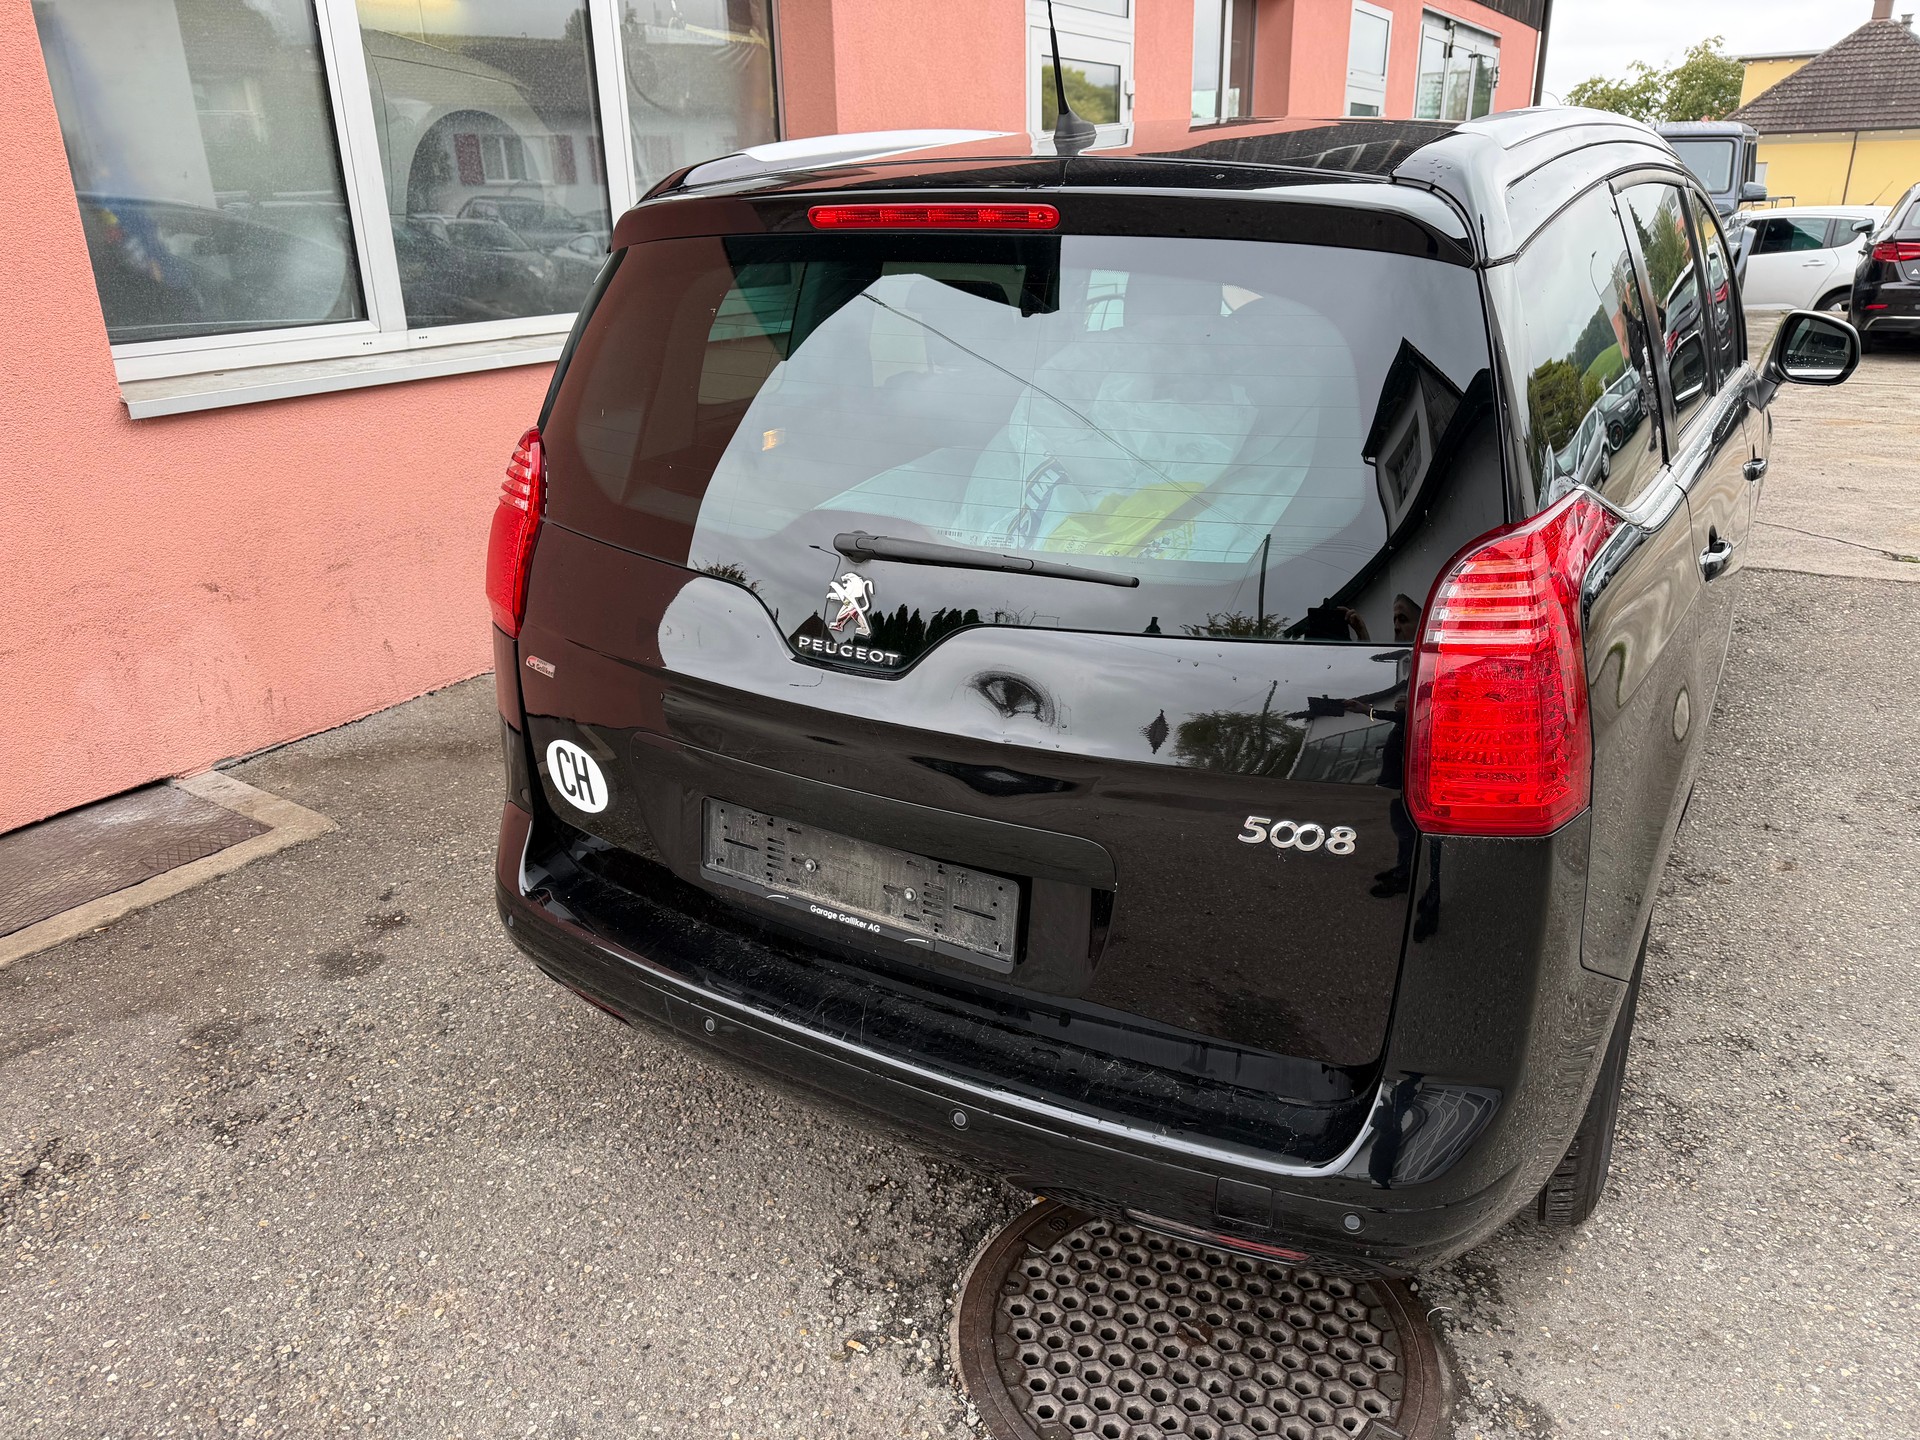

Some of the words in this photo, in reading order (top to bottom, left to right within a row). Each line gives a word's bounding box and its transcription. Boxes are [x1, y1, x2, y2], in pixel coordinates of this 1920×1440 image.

[798, 636, 899, 666] PEUGEOT
[556, 746, 596, 806] CH
[1237, 815, 1358, 855] 5008
[810, 904, 838, 919] Garage
[838, 913, 867, 929] Galliker
[867, 923, 881, 933] AG
